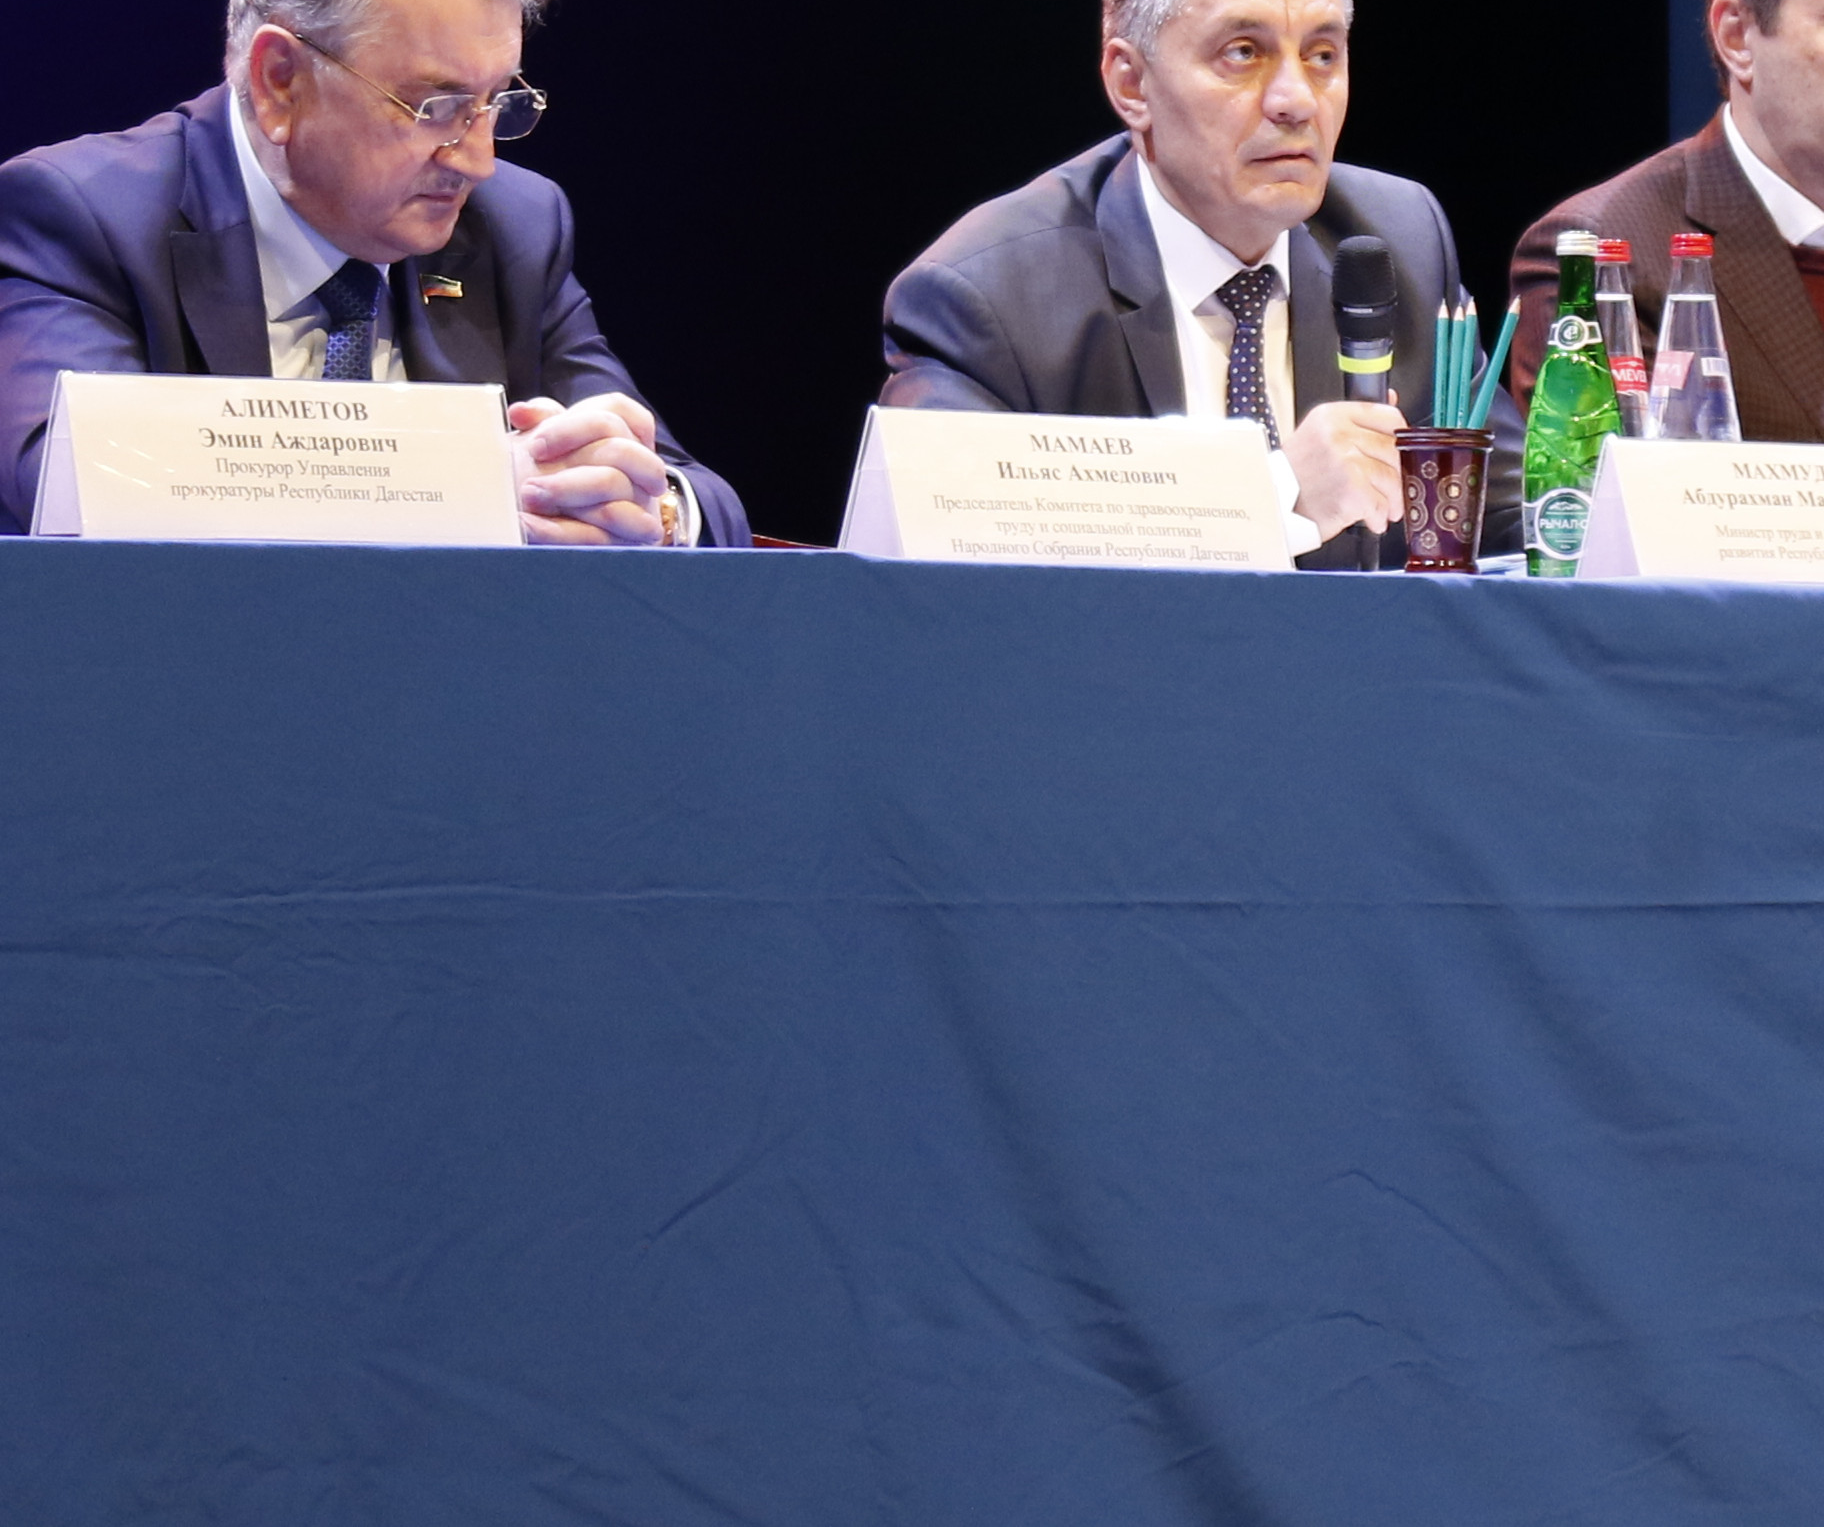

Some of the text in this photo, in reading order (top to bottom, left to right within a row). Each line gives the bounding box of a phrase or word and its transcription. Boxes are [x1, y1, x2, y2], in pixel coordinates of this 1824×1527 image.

[220, 398, 369, 421] АЛИМЕТОВ
[197, 427, 399, 456] Эмин Аждарович
[1029, 433, 1134, 456] МАМАЕВ
[215, 457, 391, 479] Прокурор Управления
[996, 460, 1179, 486] Ильяс Ахмедович
[170, 483, 445, 504] прокуратуры Республики Дагестан
[1682, 487, 1793, 510] Абдурахман
[932, 494, 1251, 522] Председатель Комитета по здравоохранению,
[995, 520, 1037, 536] труду
[1052, 520, 1135, 537] социальной
[1136, 524, 1203, 539] политики
[1714, 524, 1775, 542] Министр
[1776, 527, 1813, 543] труда
[950, 538, 1250, 562] Народного Собрания Республики Дагестан
[1719, 547, 1776, 562] развития
